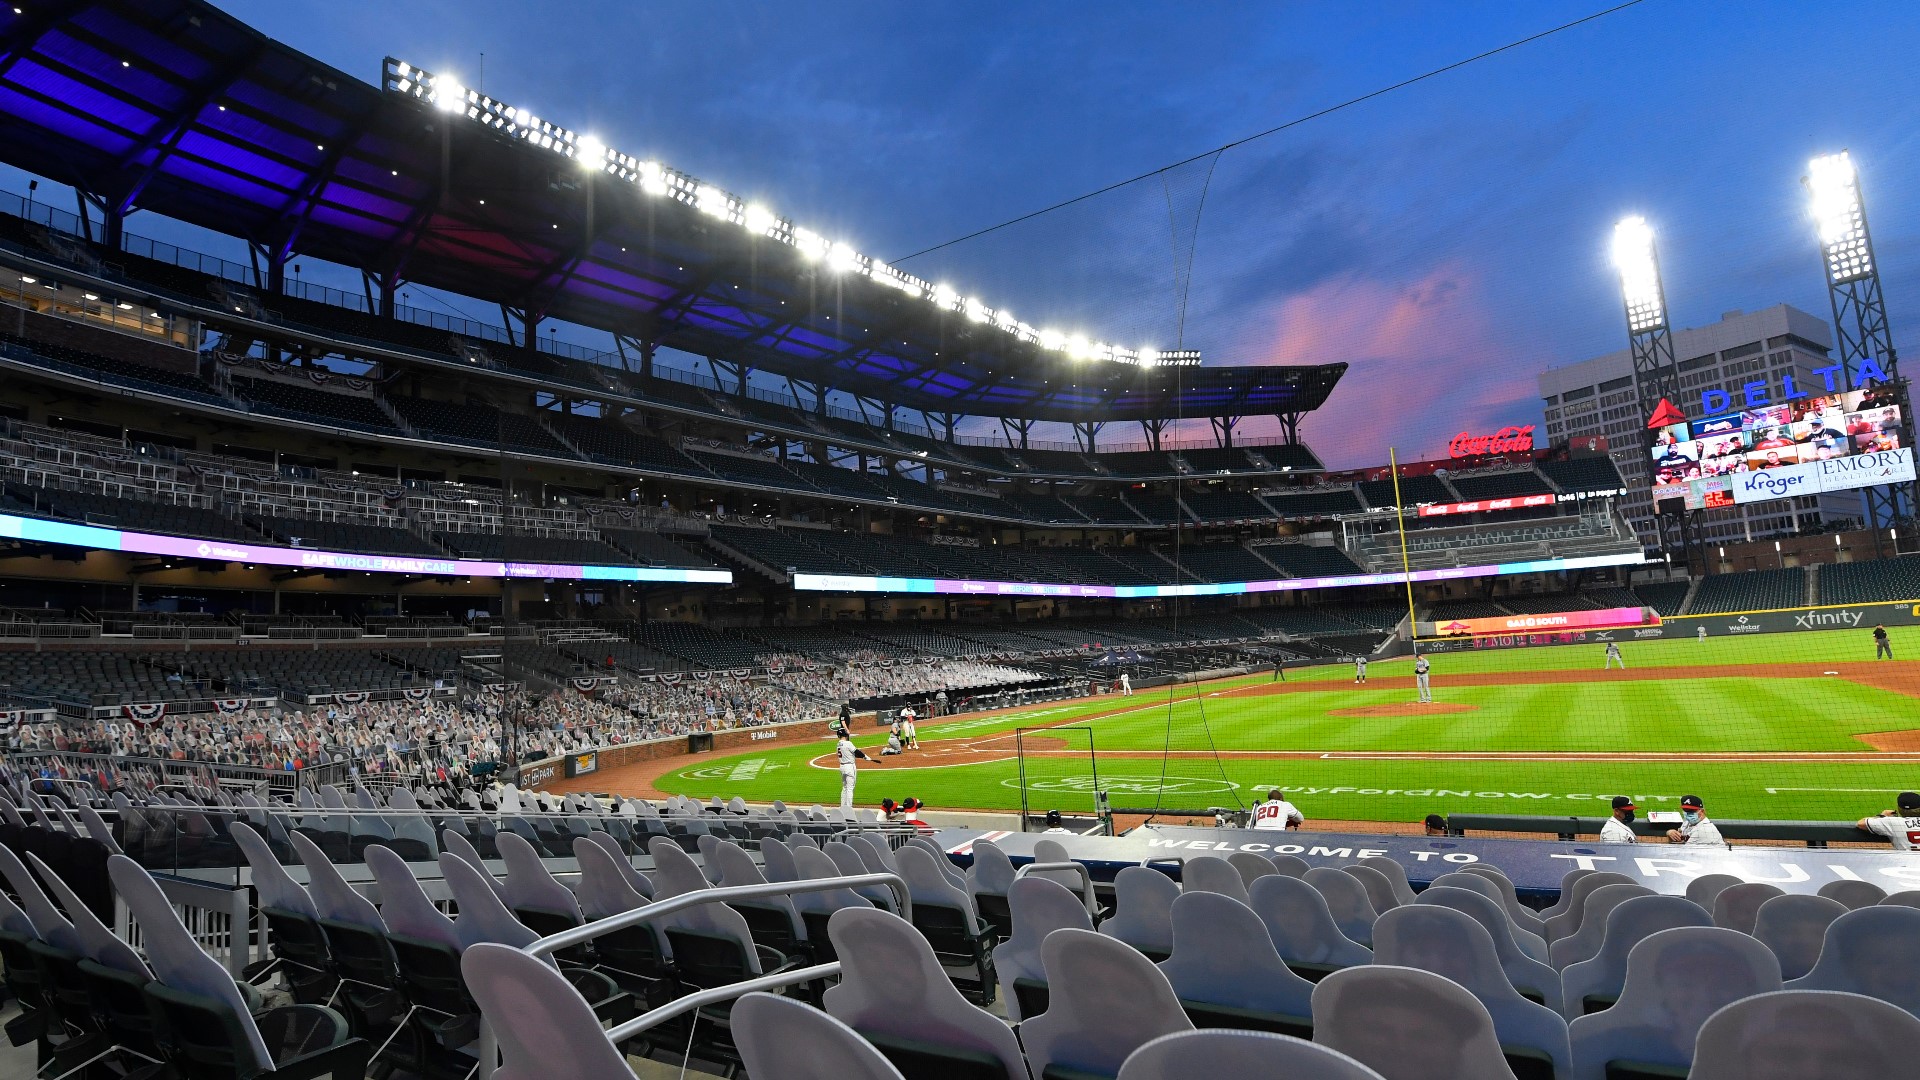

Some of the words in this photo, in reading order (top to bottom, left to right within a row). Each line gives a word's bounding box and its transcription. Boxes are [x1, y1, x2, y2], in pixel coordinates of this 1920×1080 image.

[1702, 358, 1888, 415] DELTA
[1449, 425, 1536, 458] Coca-Cola
[1823, 449, 1906, 474] EMORY
[1745, 472, 1804, 494] Kroger
[1705, 492, 1723, 501] 22
[1707, 500, 1734, 508] MILLION
[1536, 616, 1567, 626] SOUTH
[1795, 611, 1863, 628] xfinity
[540, 766, 554, 780] PARK
[1257, 806, 1279, 821] 20
[1148, 838, 1388, 859] WELCOME
[1410, 850, 1479, 864] TO
